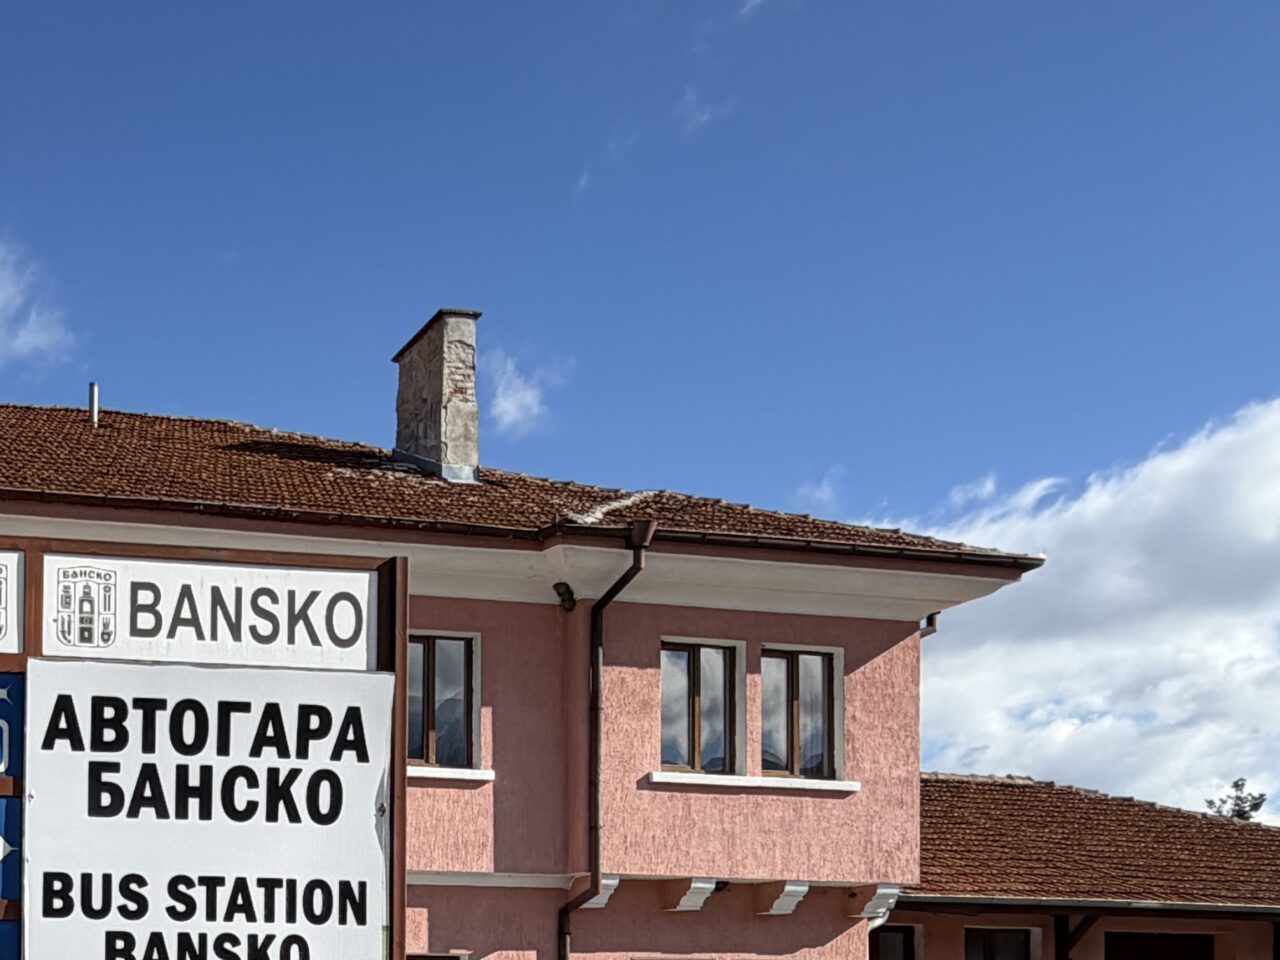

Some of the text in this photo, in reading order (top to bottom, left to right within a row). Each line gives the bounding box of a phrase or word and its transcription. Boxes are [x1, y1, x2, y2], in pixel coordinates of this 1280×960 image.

[62, 570, 112, 582] БАНСКО
[129, 581, 363, 648] BANSKO
[41, 694, 370, 763] АВТОГАРА
[87, 760, 343, 826] БАНСКО
[42, 871, 367, 926] BUS STATION
